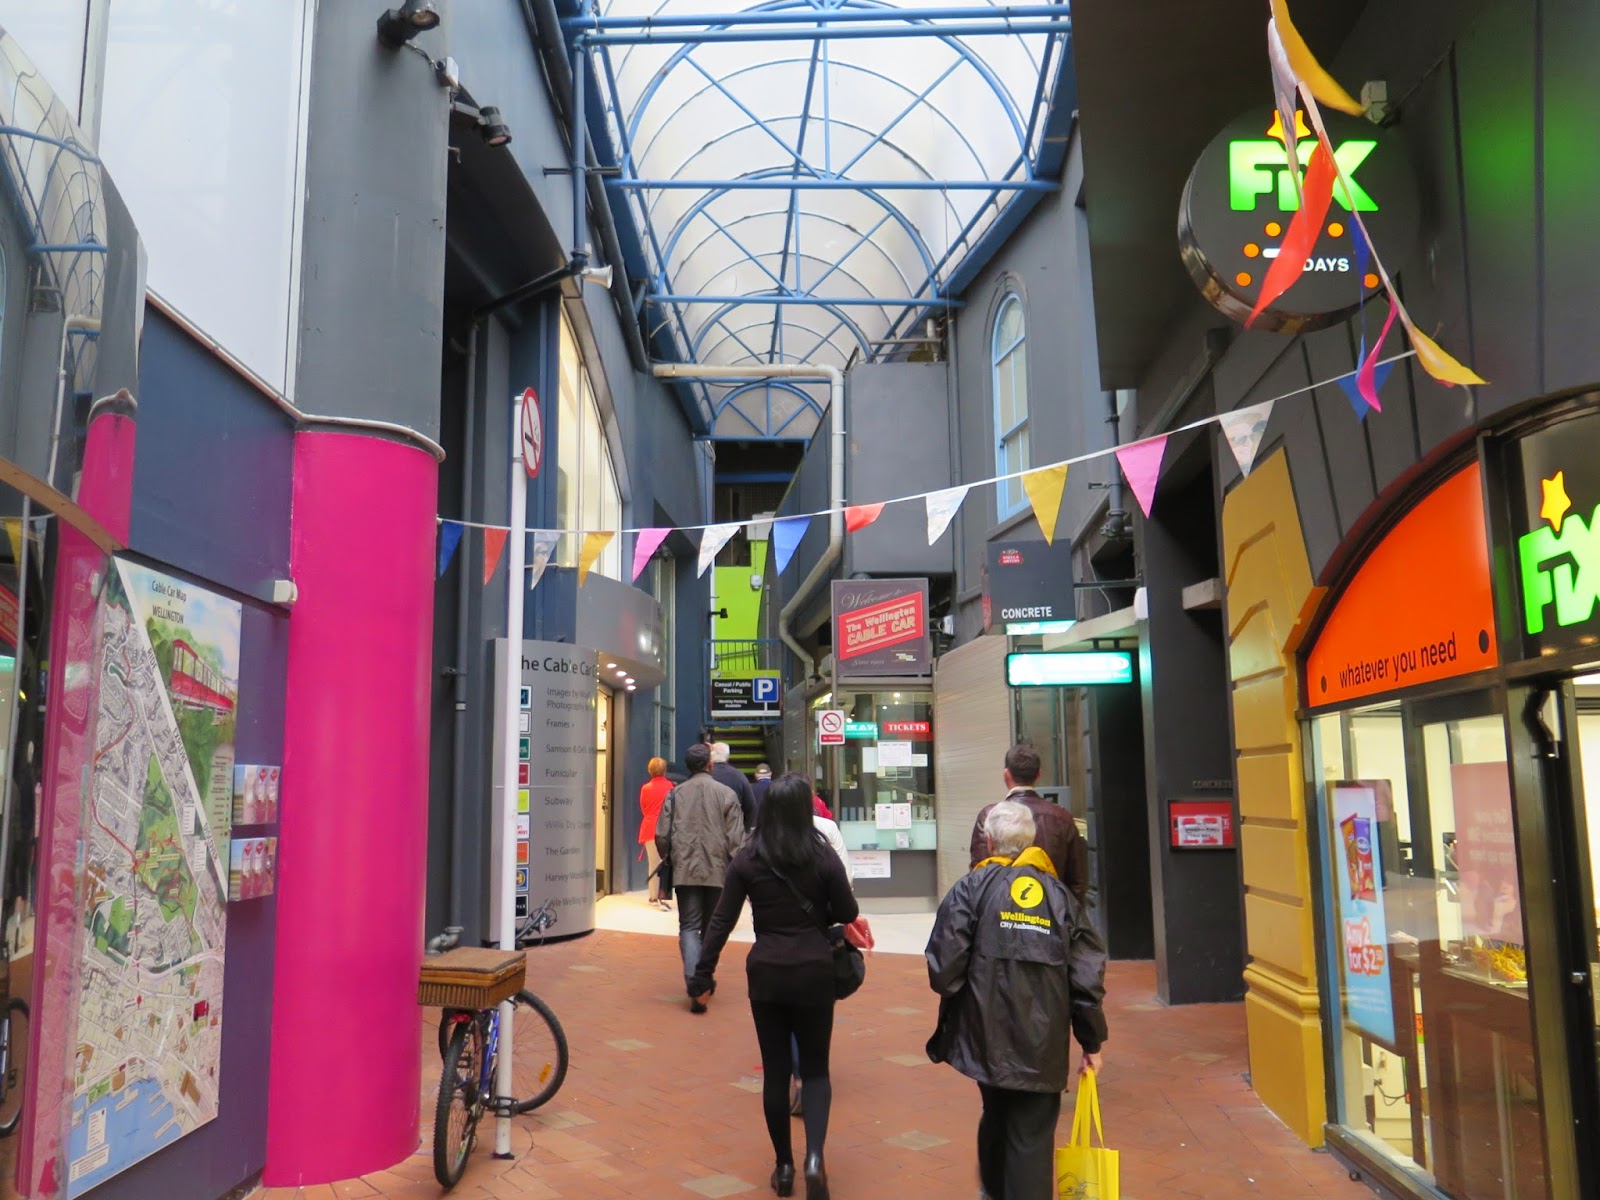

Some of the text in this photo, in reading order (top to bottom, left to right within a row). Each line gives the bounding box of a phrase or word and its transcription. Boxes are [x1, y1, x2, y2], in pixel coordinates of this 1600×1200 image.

[1303, 258, 1350, 272] DAYS
[151, 580, 187, 604] Cable Car Map
[841, 589, 893, 609] Welcome
[152, 605, 184, 624] WELLINGTON
[1001, 606, 1053, 619] CONCRETE
[846, 607, 915, 633] The Wellington
[847, 616, 915, 646] CABLE CAR
[521, 654, 540, 671] he
[543, 657, 579, 674] Cable
[1339, 631, 1457, 689] whatever you need
[547, 688, 571, 699] Images
[758, 679, 774, 700] P
[546, 718, 570, 729] Frames
[888, 724, 927, 732] TICKETS
[545, 769, 577, 778] Funicular
[544, 797, 573, 807] Subway
[545, 847, 559, 857] The
[545, 873, 569, 883] Harvey
[1000, 911, 1051, 927] Wellington
[1000, 921, 1013, 930] City
